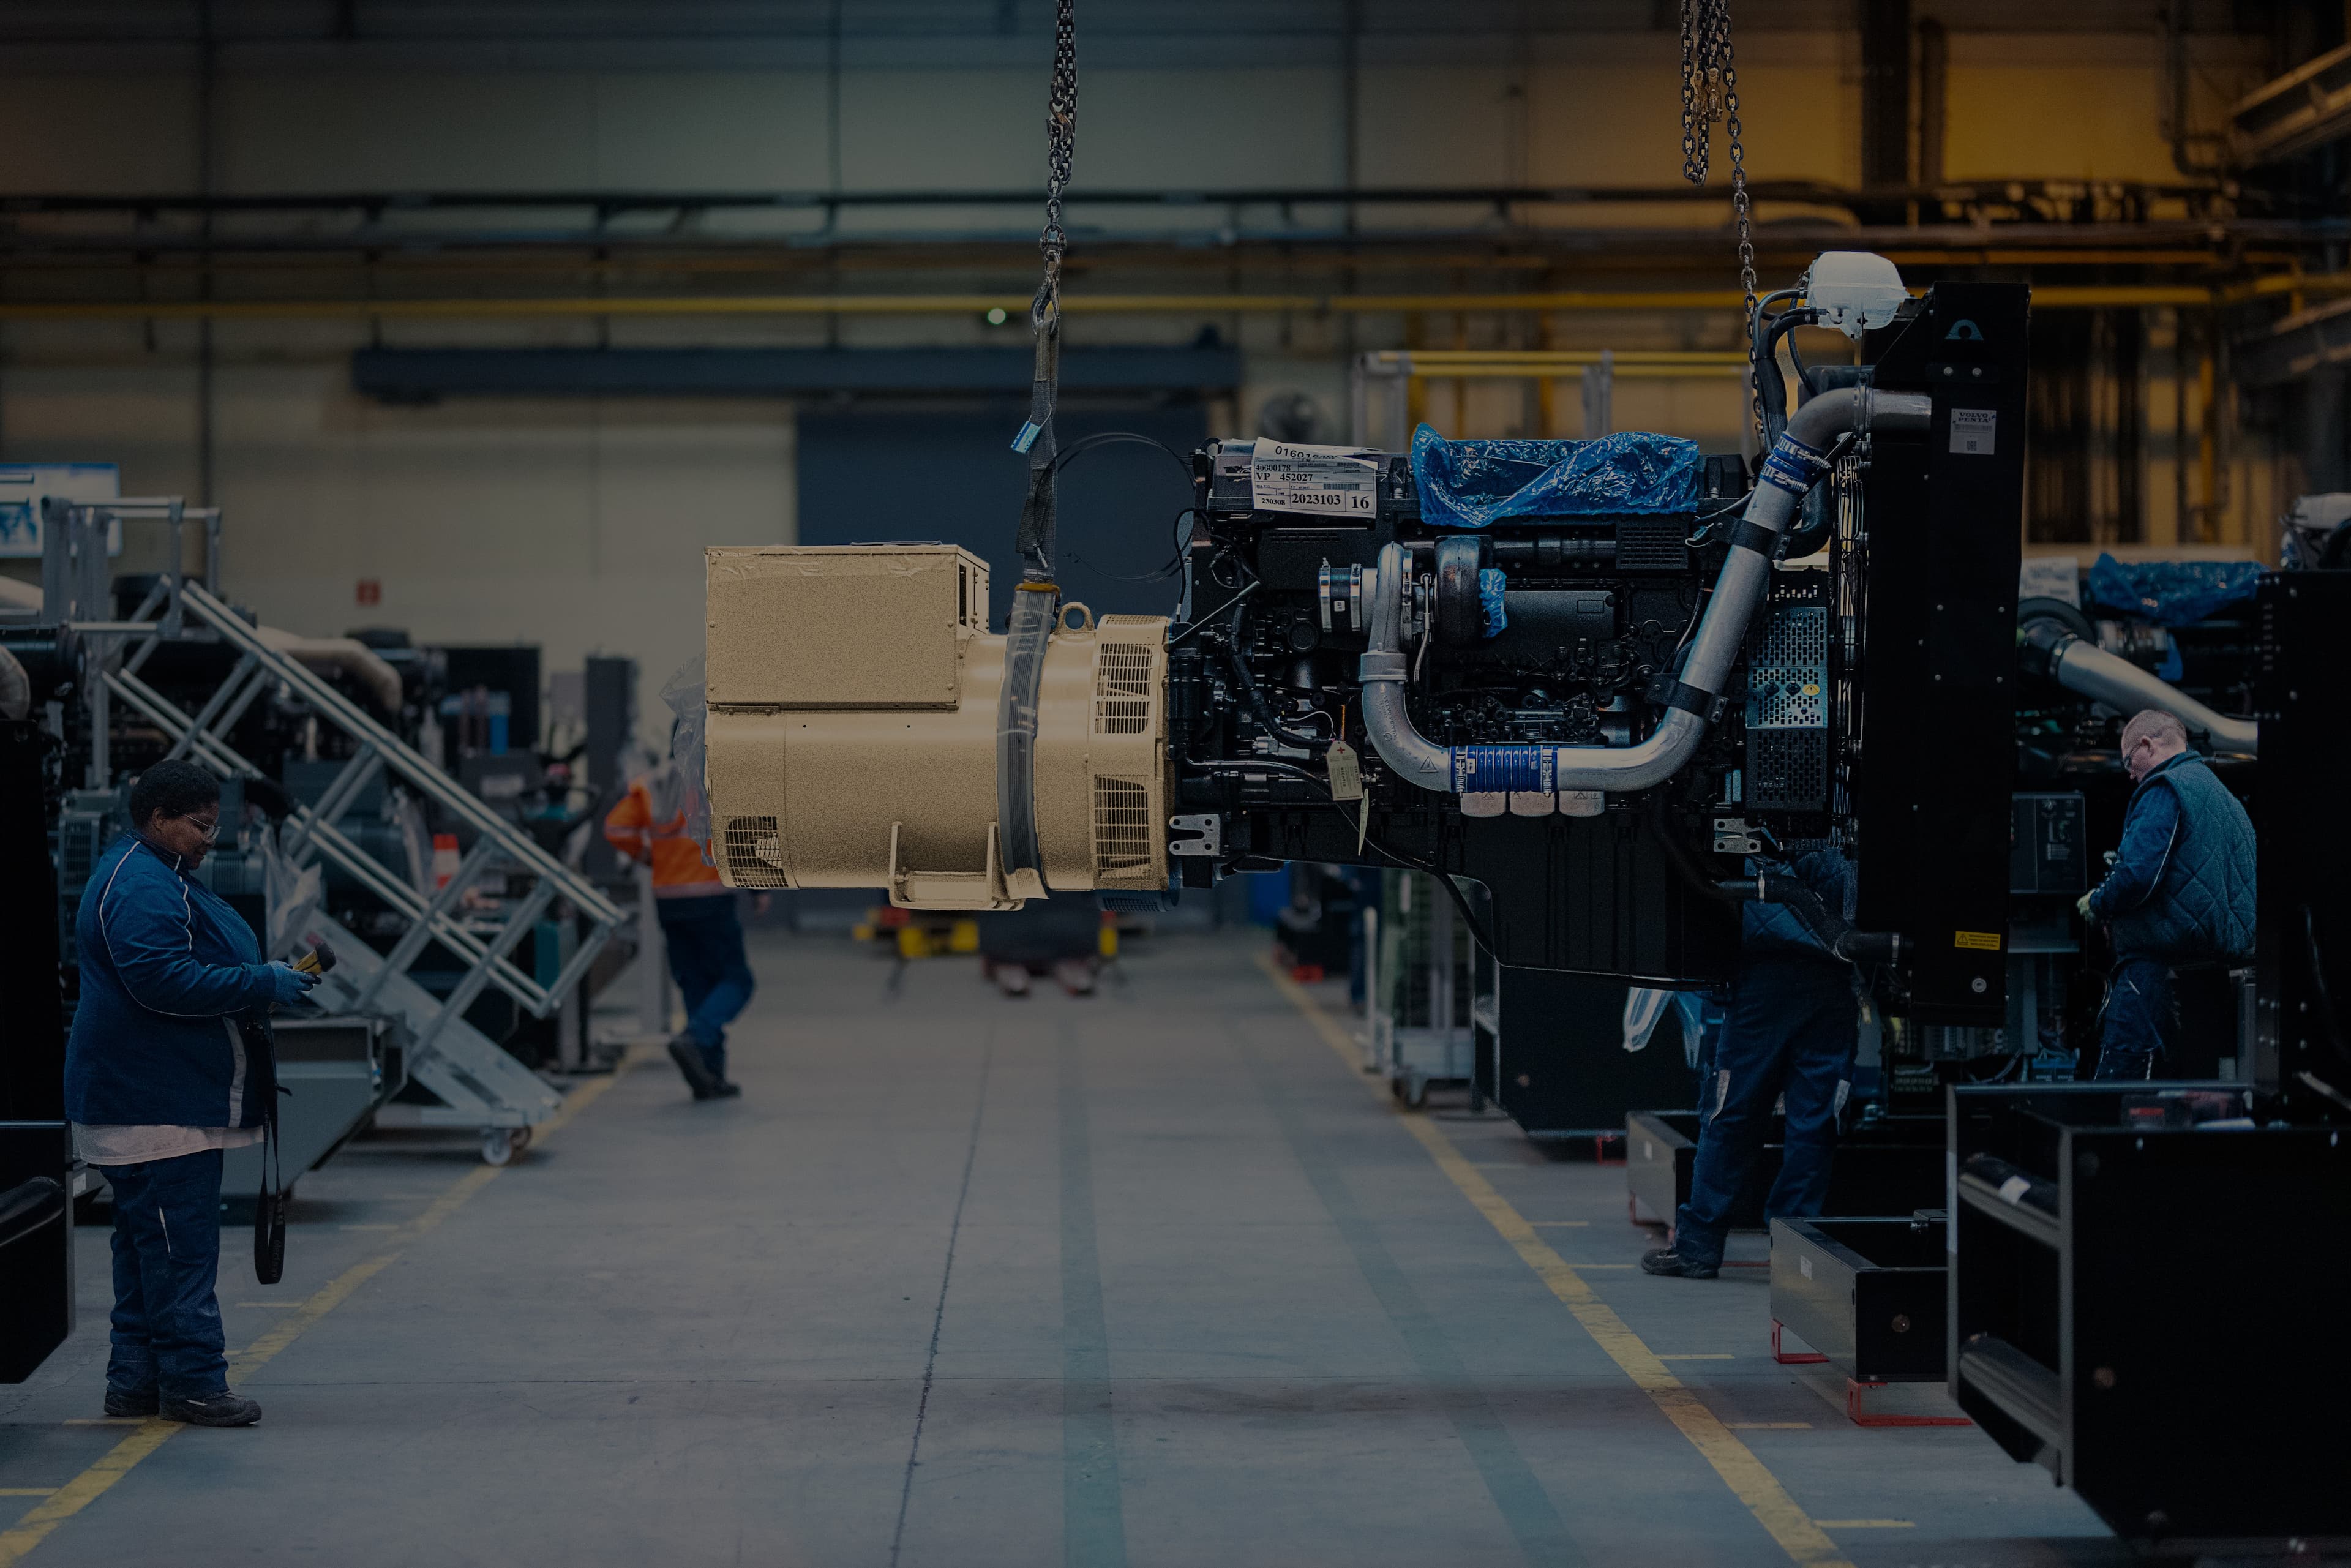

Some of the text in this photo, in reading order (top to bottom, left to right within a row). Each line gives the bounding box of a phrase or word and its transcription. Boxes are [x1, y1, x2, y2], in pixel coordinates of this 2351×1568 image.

[1256, 472, 1270, 481] VP
[1280, 473, 1313, 482] 452027
[1292, 493, 1341, 505] 2023103
[1351, 495, 1370, 509] 16
